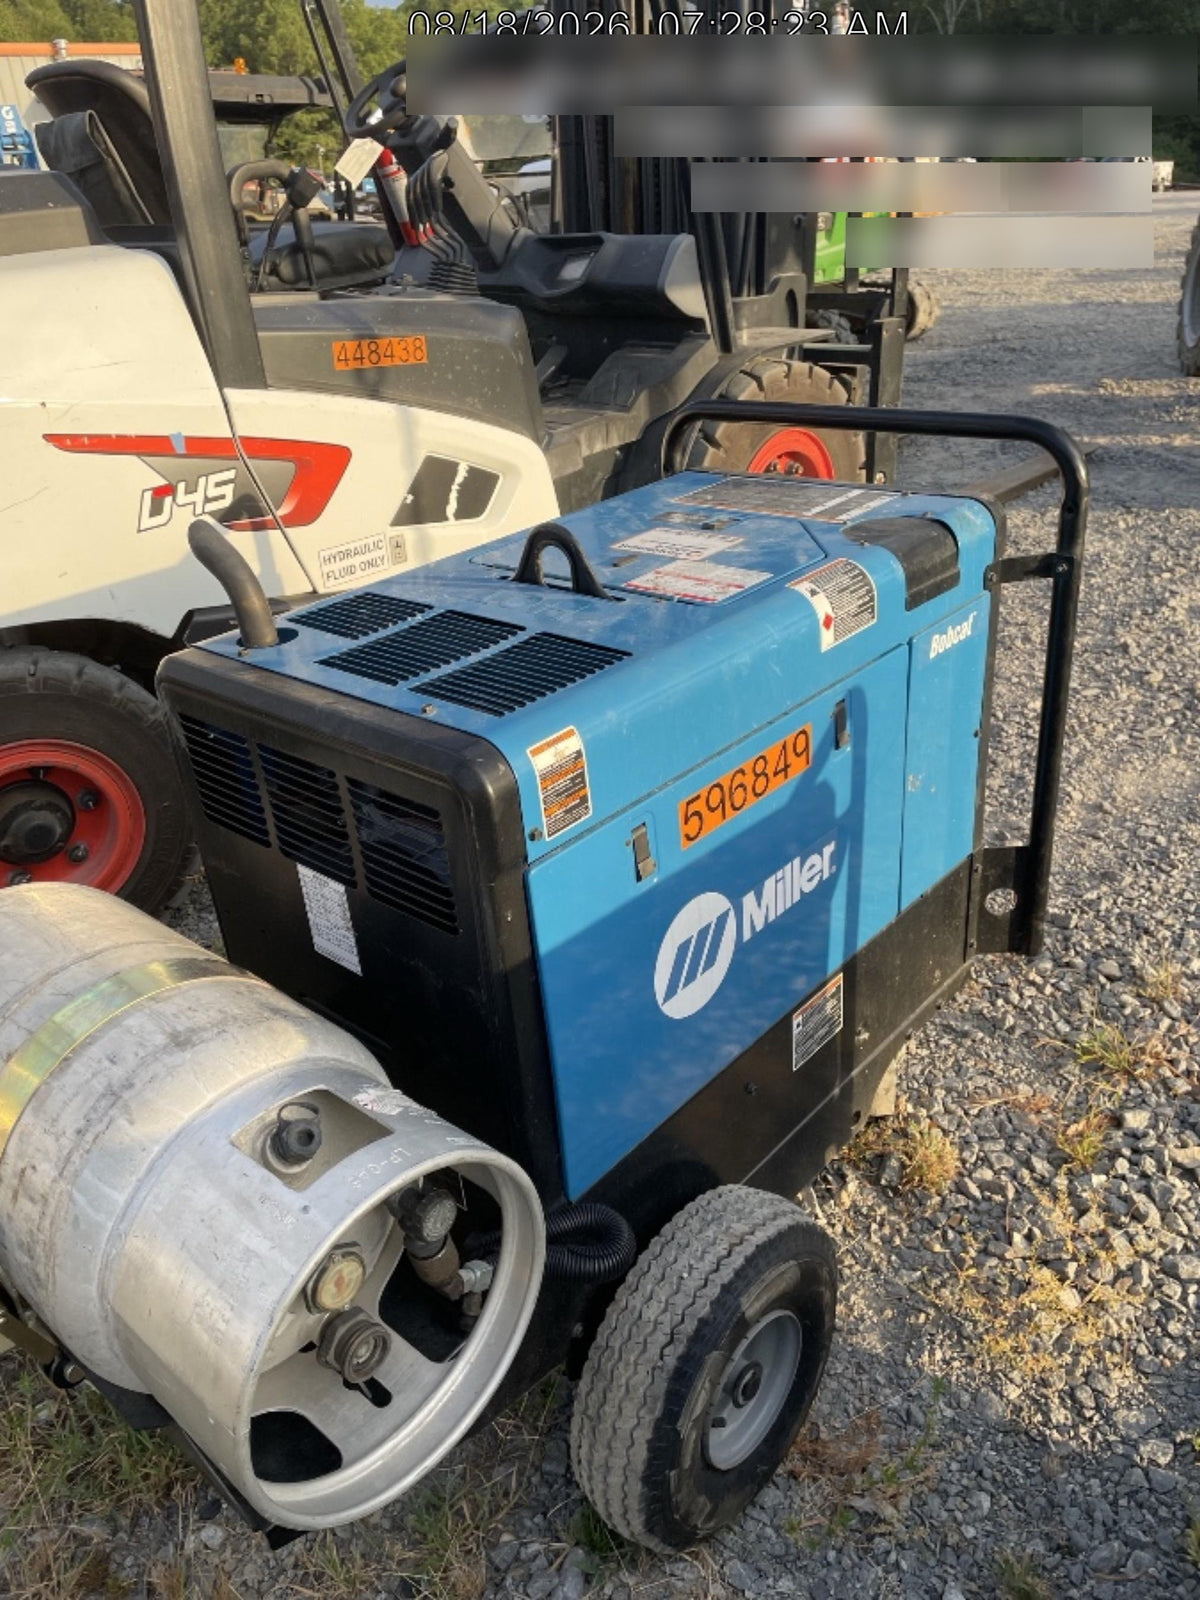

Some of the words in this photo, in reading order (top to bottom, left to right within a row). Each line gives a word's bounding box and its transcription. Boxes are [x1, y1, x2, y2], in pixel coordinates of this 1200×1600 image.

[337, 337, 425, 367] 448438
[323, 538, 384, 566] HYDRAULIC
[326, 564, 356, 581] FLUID
[359, 554, 385, 572] ONLY
[929, 611, 976, 660] Bobcat
[684, 728, 810, 842] 596849
[742, 841, 835, 943] Miller
